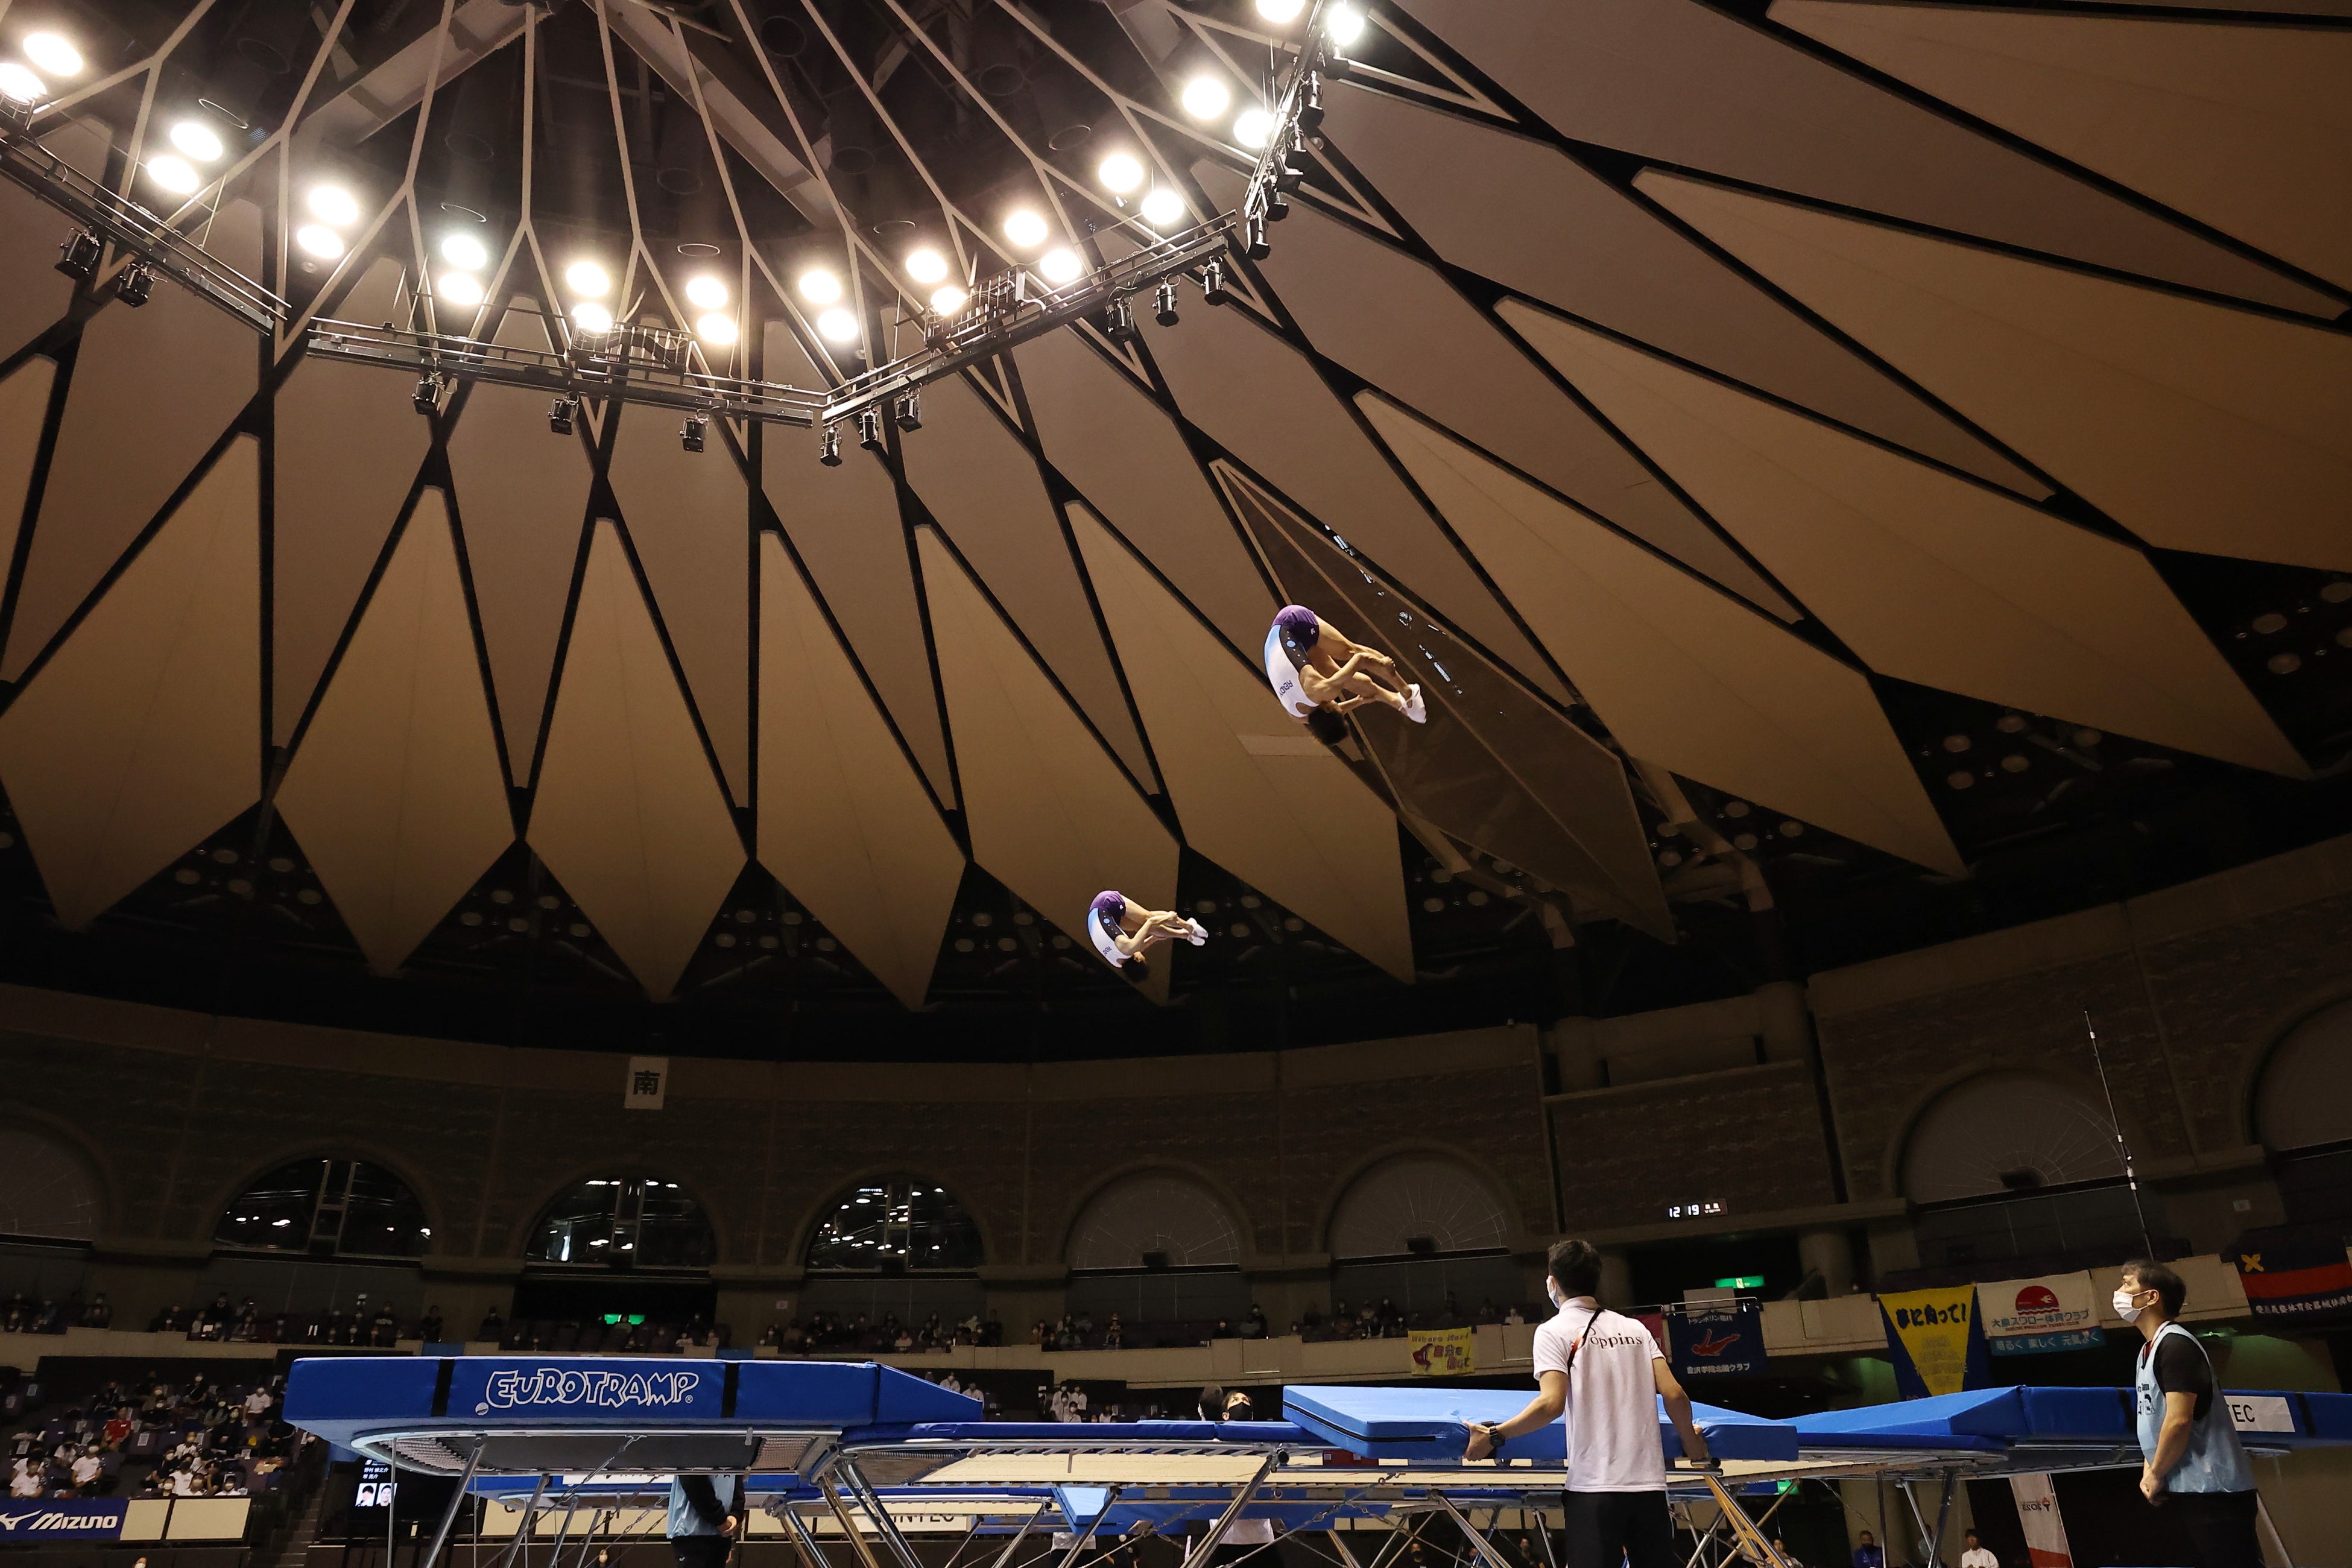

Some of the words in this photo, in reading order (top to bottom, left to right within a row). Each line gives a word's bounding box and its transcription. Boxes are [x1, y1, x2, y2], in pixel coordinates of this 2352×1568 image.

[633, 1070, 660, 1095] 南
[1669, 1206, 1680, 1218] 12
[1688, 1204, 1699, 1215] 19
[485, 1368, 699, 1408] EUROTRAMP
[2227, 1405, 2256, 1423] EC
[28, 1513, 118, 1530] MIZUNO
